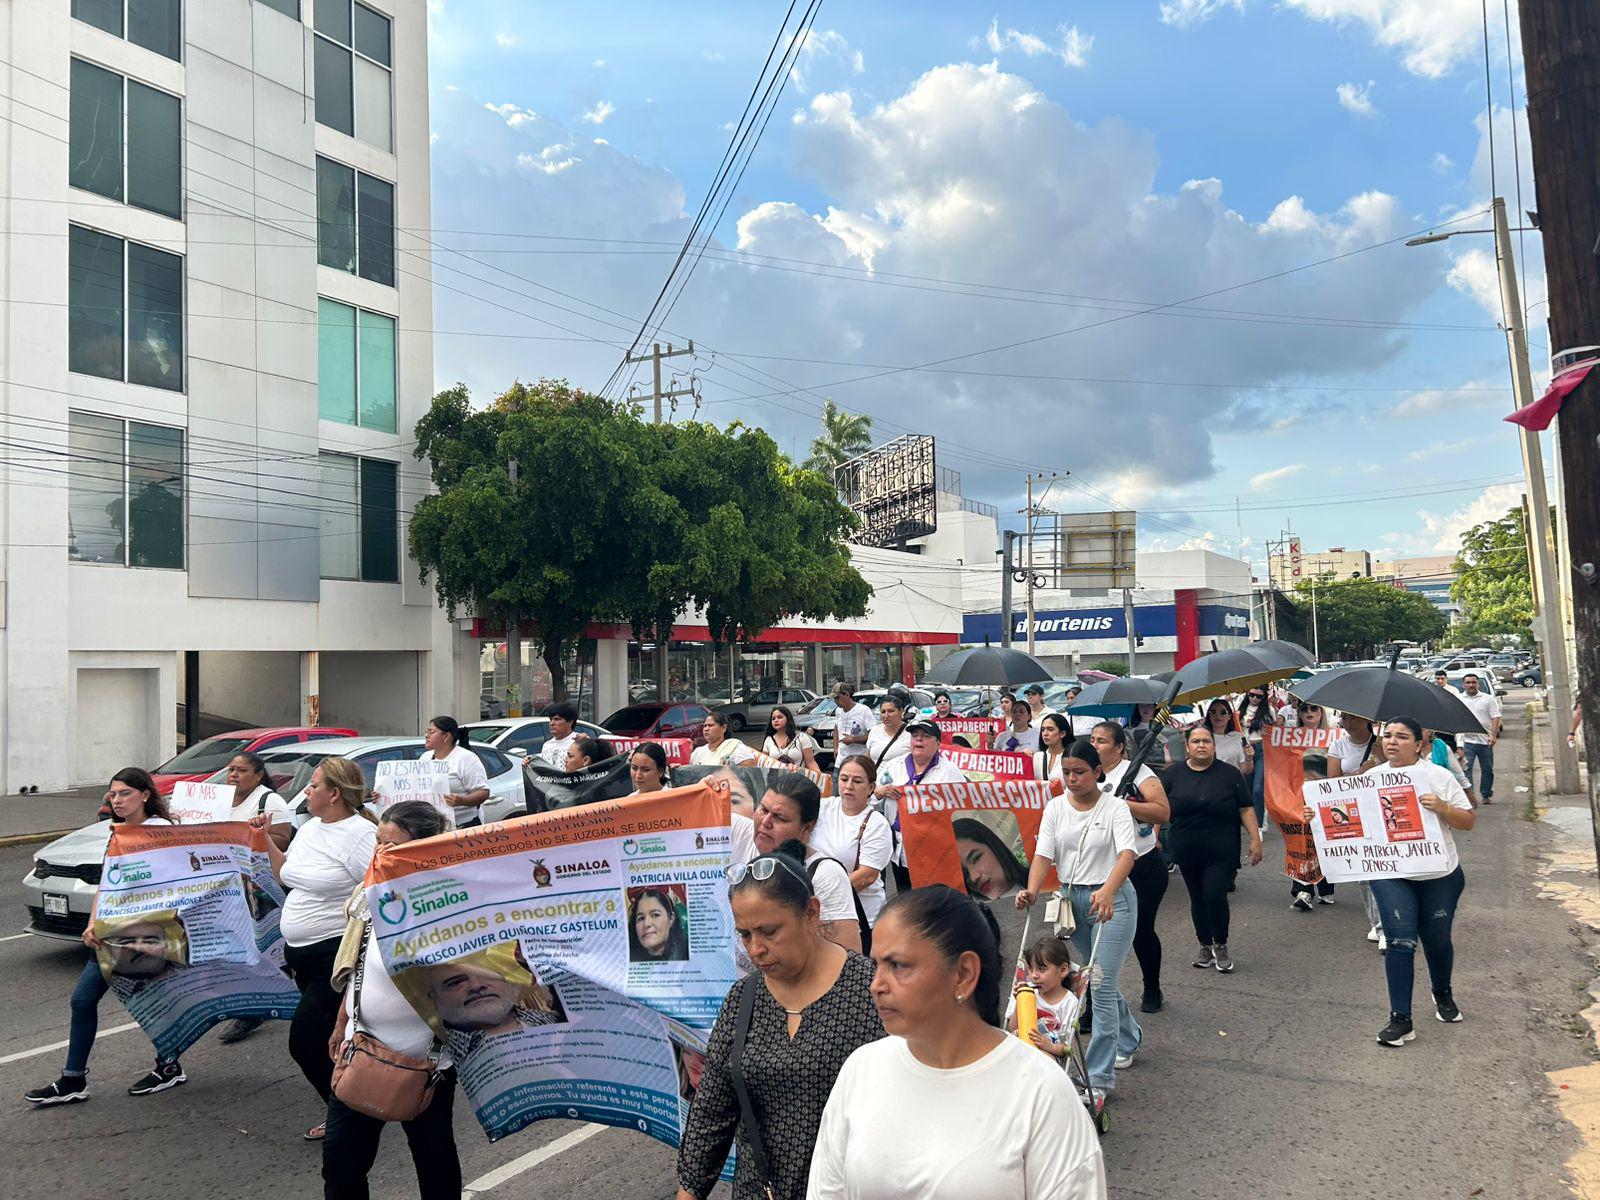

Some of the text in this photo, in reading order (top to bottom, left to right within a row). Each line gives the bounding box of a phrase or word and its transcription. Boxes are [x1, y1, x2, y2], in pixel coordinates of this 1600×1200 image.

[1318, 772, 1412, 795] NO ESTAMOS TODOS
[414, 859, 439, 870] LOS
[439, 842, 533, 866] DESAPARECIDOS
[535, 837, 552, 847] NO
[554, 832, 570, 844] SE
[620, 822, 637, 834] SE
[637, 816, 682, 832] BUSCAN
[640, 844, 667, 854] Sinaloa
[1323, 845, 1358, 858] FALTAN
[1405, 841, 1441, 858] JAVIER
[201, 854, 230, 862] SINALOA
[555, 859, 610, 874] SINALOA
[1345, 858, 1399, 873] Y DENISSE
[630, 873, 672, 884] PATRICIA
[673, 871, 698, 881] VILLA
[167, 888, 174, 896] a
[140, 901, 165, 913] JAVIER
[411, 890, 470, 917] Sinaloa
[494, 911, 506, 924] a
[510, 898, 600, 923] encontrar
[605, 899, 616, 912] a
[392, 919, 618, 972] FRANCISCO JAVIER QUIÑONEZ GASTELUM
[354, 953, 367, 991] BIMBA
[514, 1081, 573, 1098] información
[576, 1082, 618, 1094] referente
[620, 1088, 627, 1096] a
[629, 1089, 649, 1100] esta
[651, 1095, 680, 1112] person
[565, 1090, 579, 1099] Tu
[580, 1091, 608, 1102] ayuda
[609, 1096, 620, 1105] es
[621, 1098, 641, 1110] muy
[642, 1101, 680, 1122] importan
